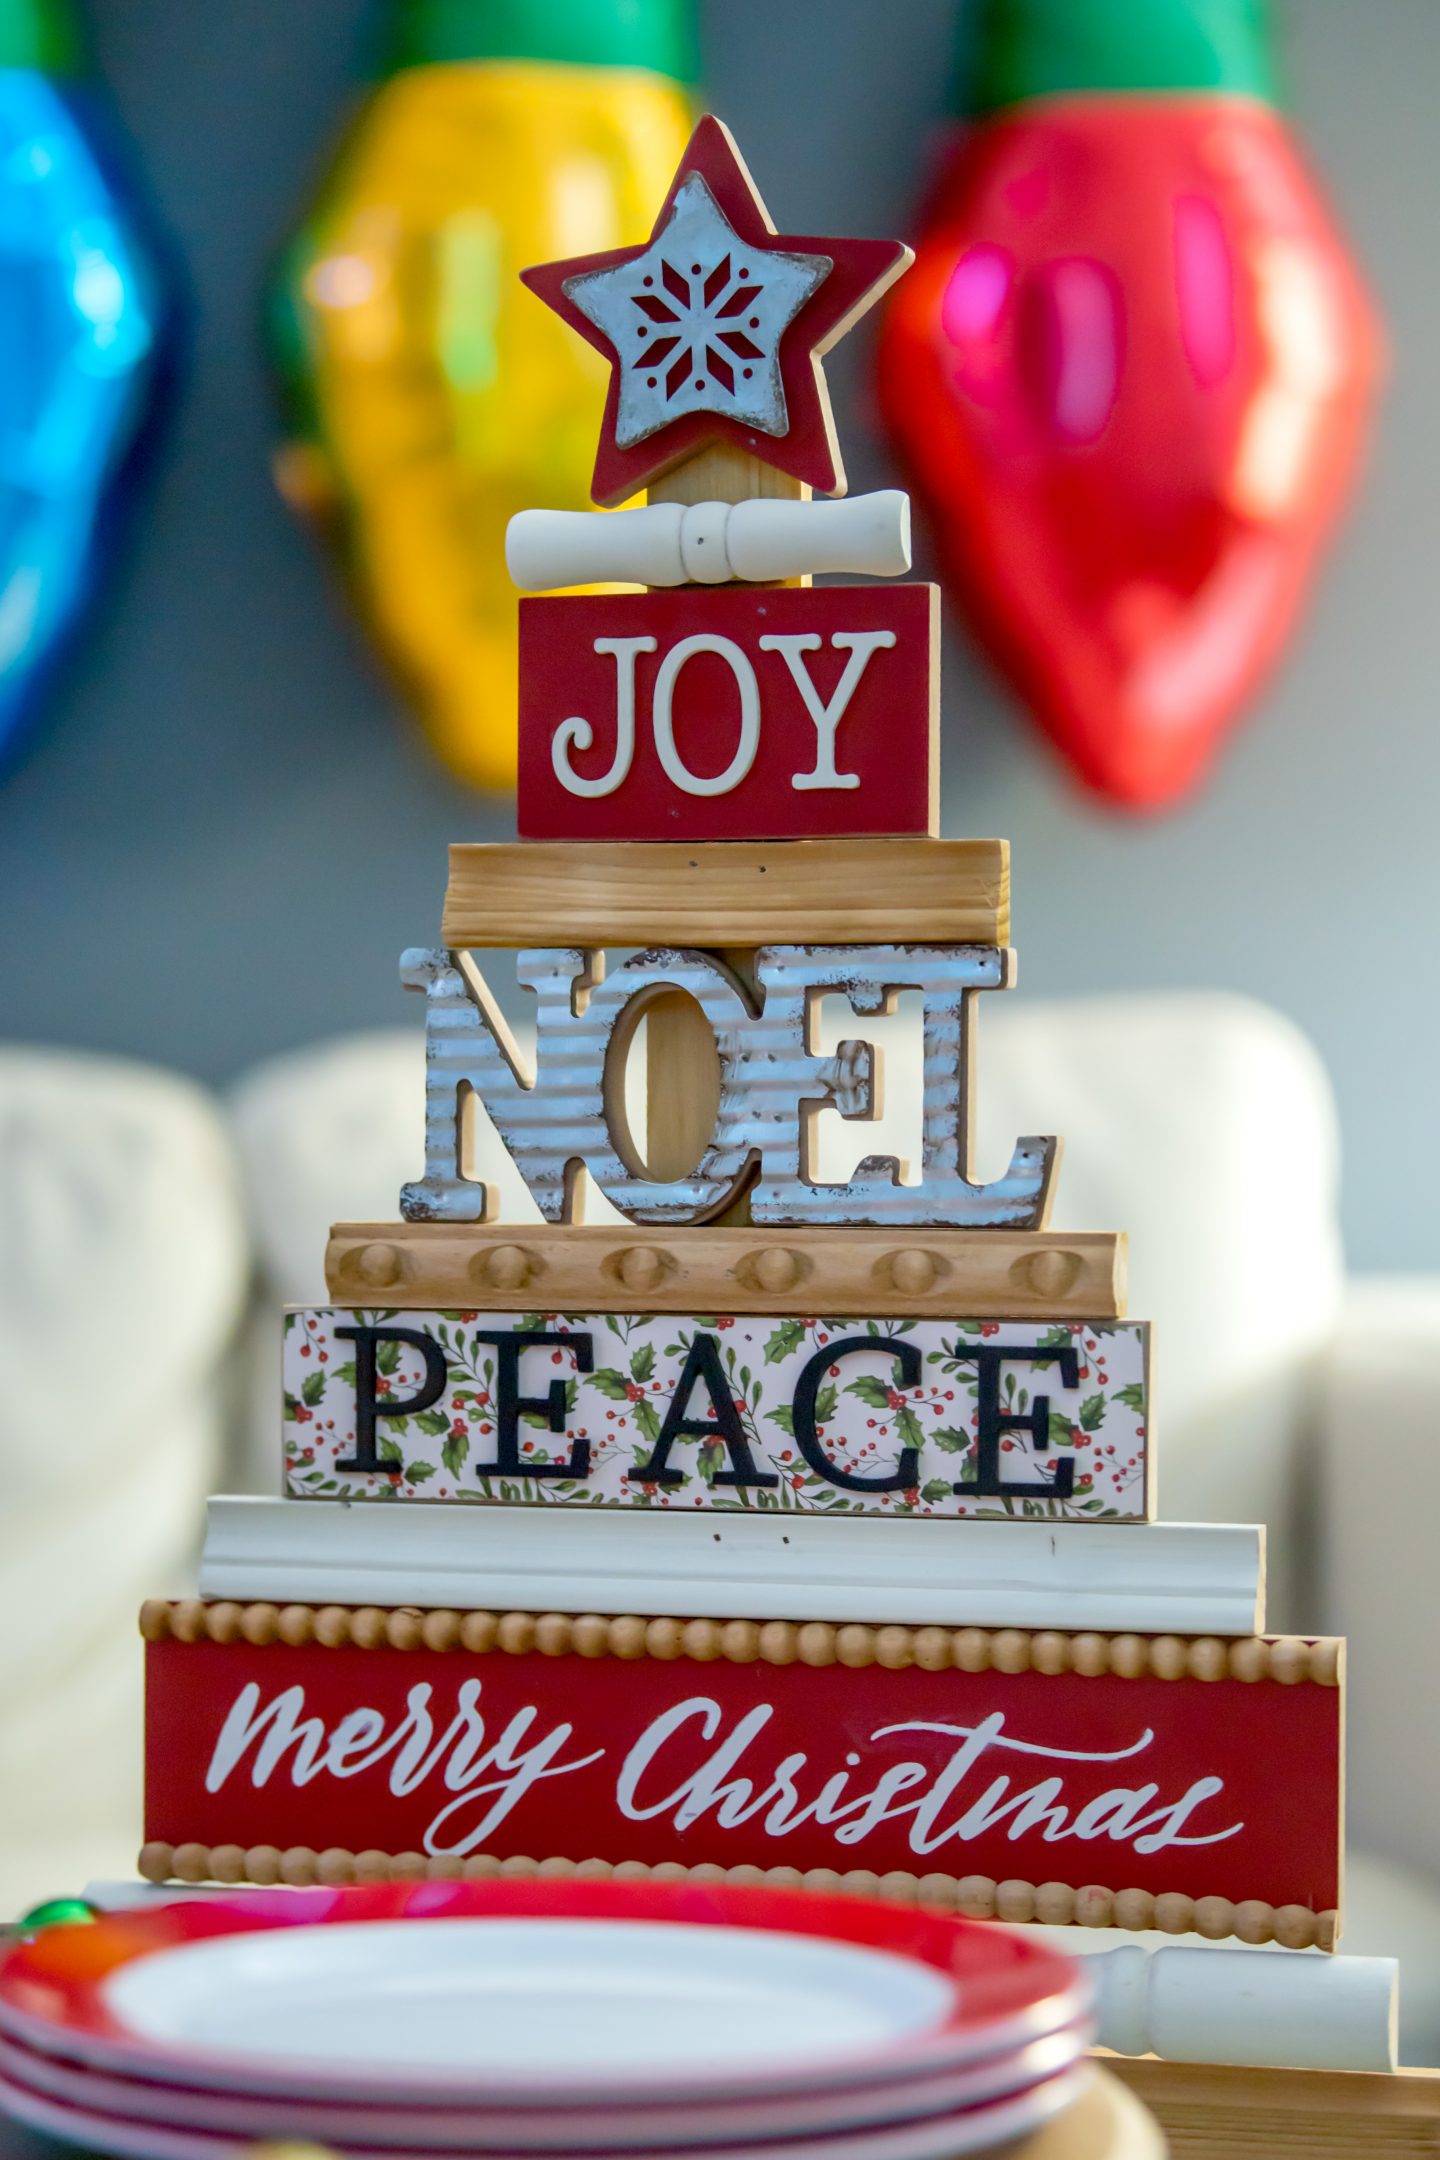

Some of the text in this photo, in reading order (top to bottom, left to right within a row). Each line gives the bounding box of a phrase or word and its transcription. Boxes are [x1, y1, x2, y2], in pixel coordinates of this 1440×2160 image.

[551, 629, 897, 798] JOY
[398, 944, 1064, 1230] NOEL
[333, 1325, 1079, 1498] PEACE
[615, 1696, 1244, 1855] Christmas
